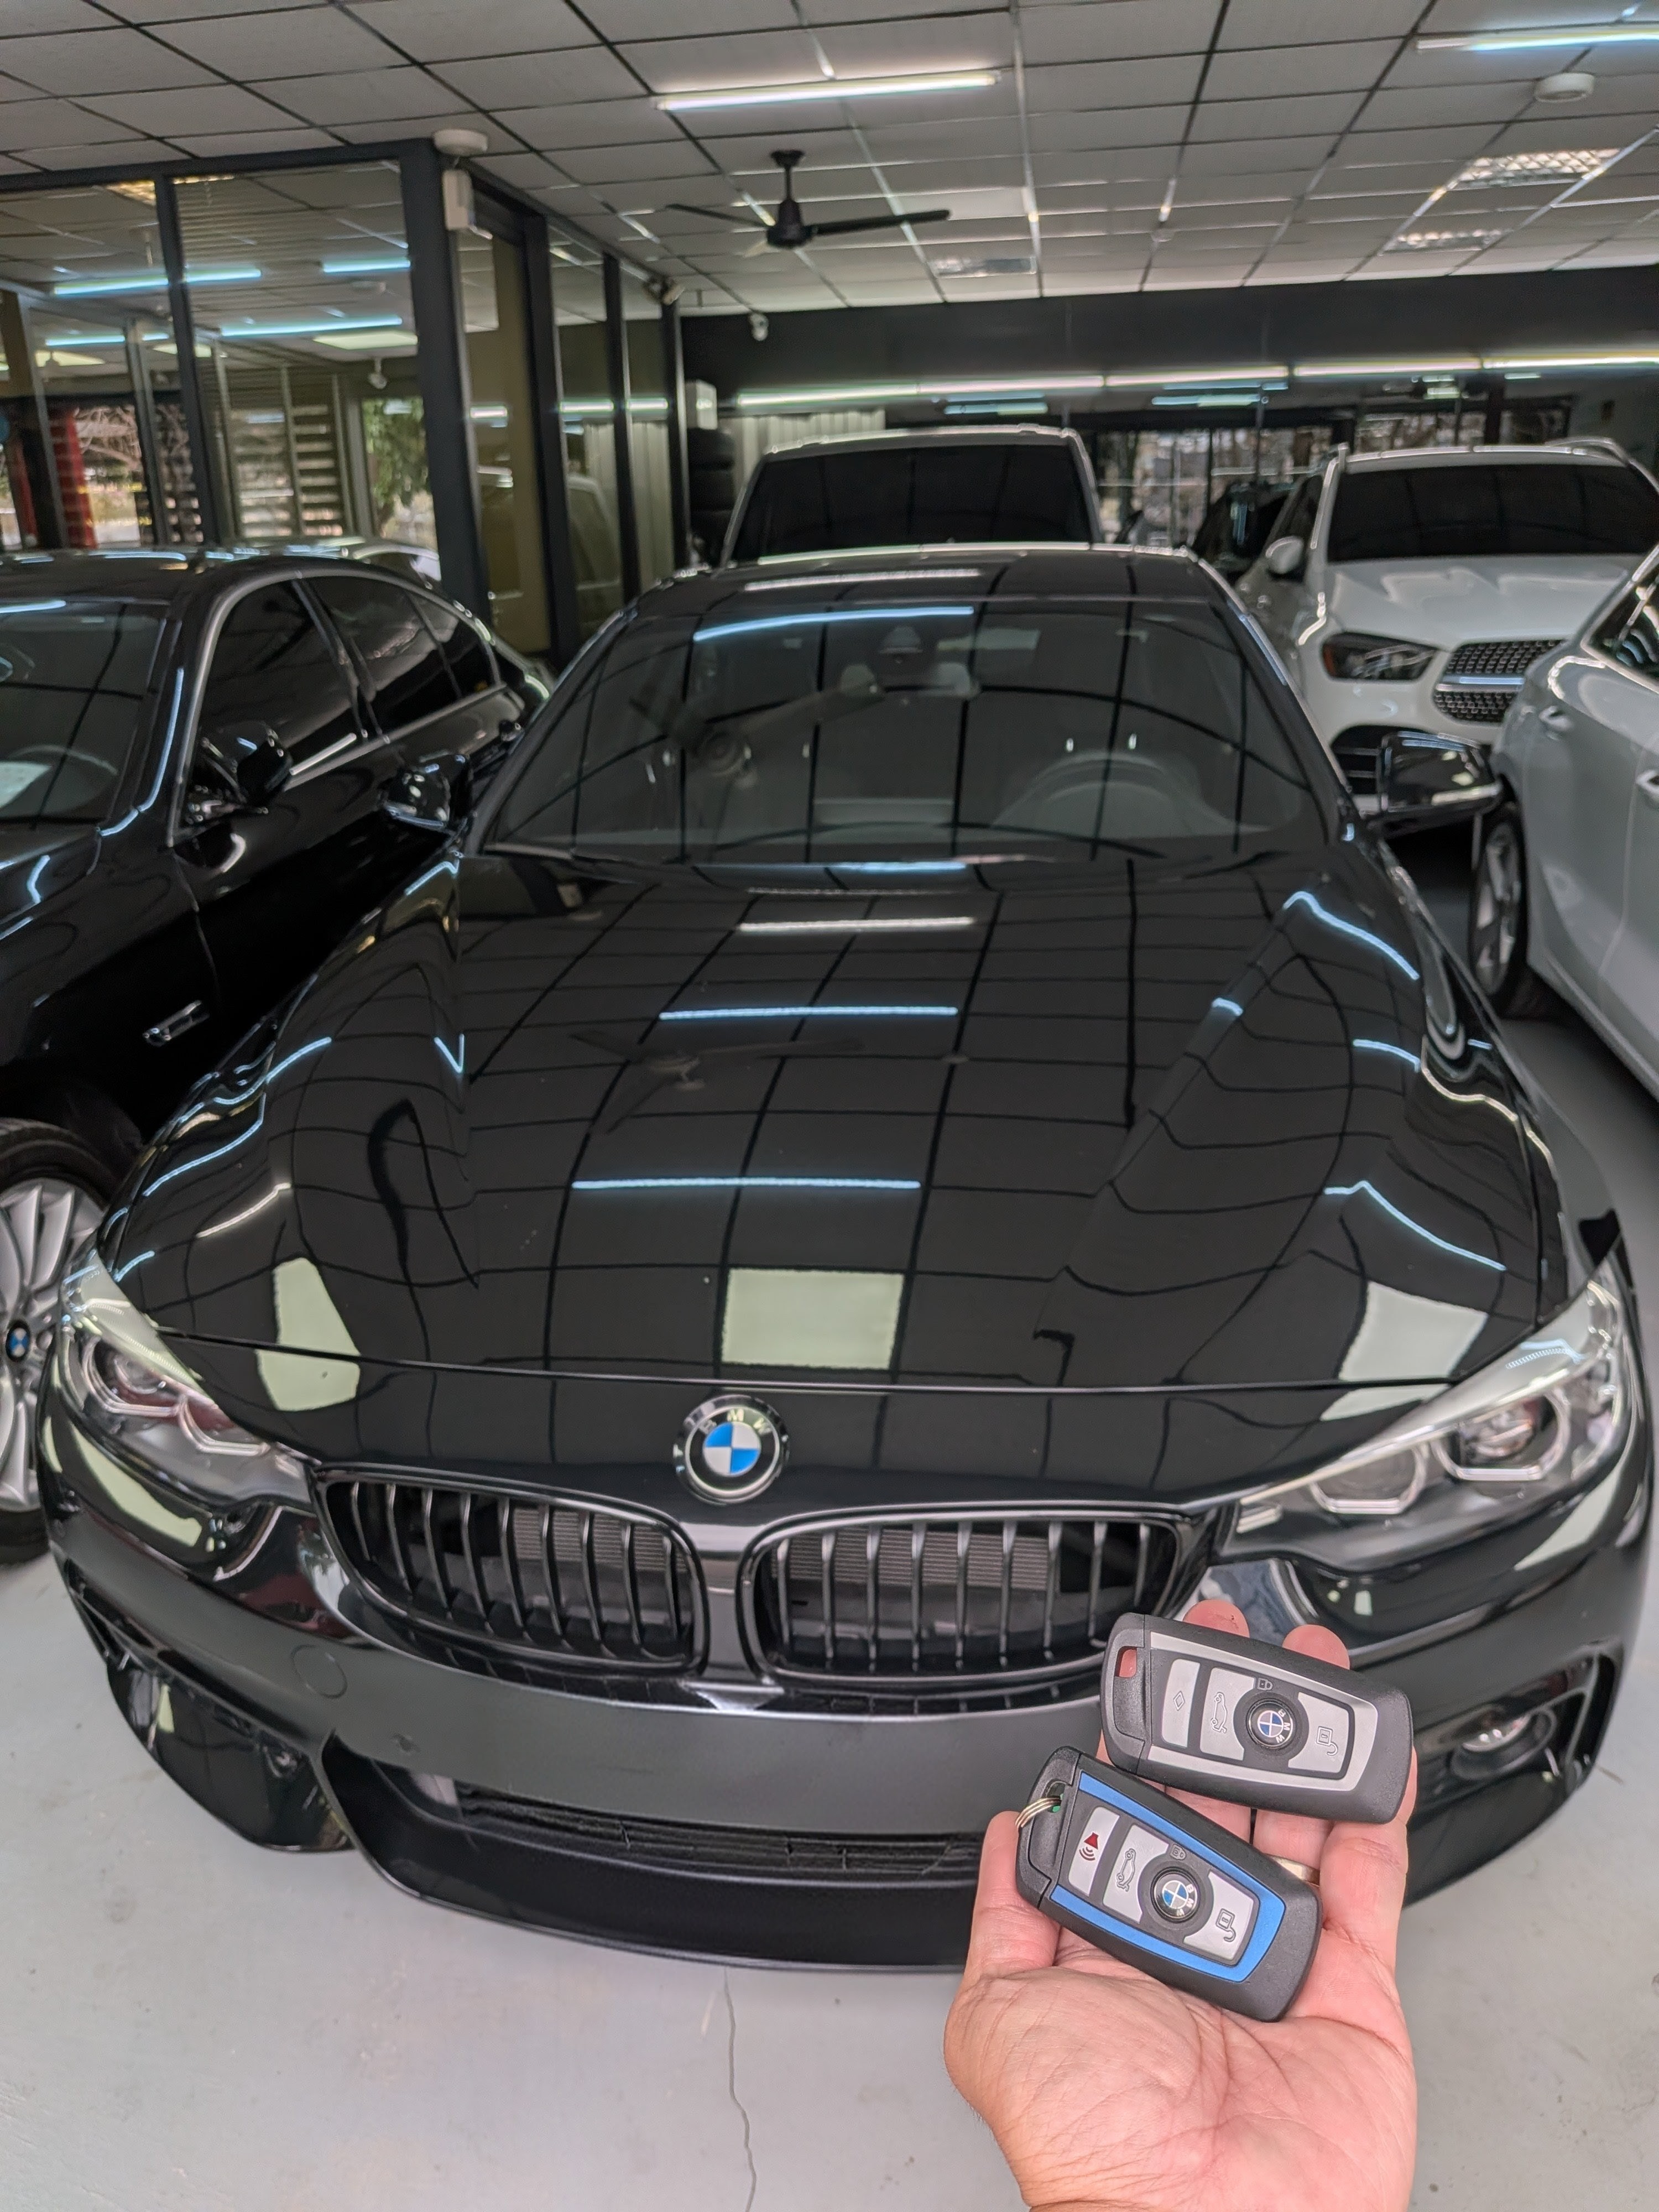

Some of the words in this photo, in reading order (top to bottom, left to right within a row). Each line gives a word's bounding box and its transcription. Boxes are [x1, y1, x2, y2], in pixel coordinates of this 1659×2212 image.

[698, 1408, 773, 1436] BMW
[1275, 1708, 1291, 1743] BMW
[1176, 1884, 1194, 1916] BMW
